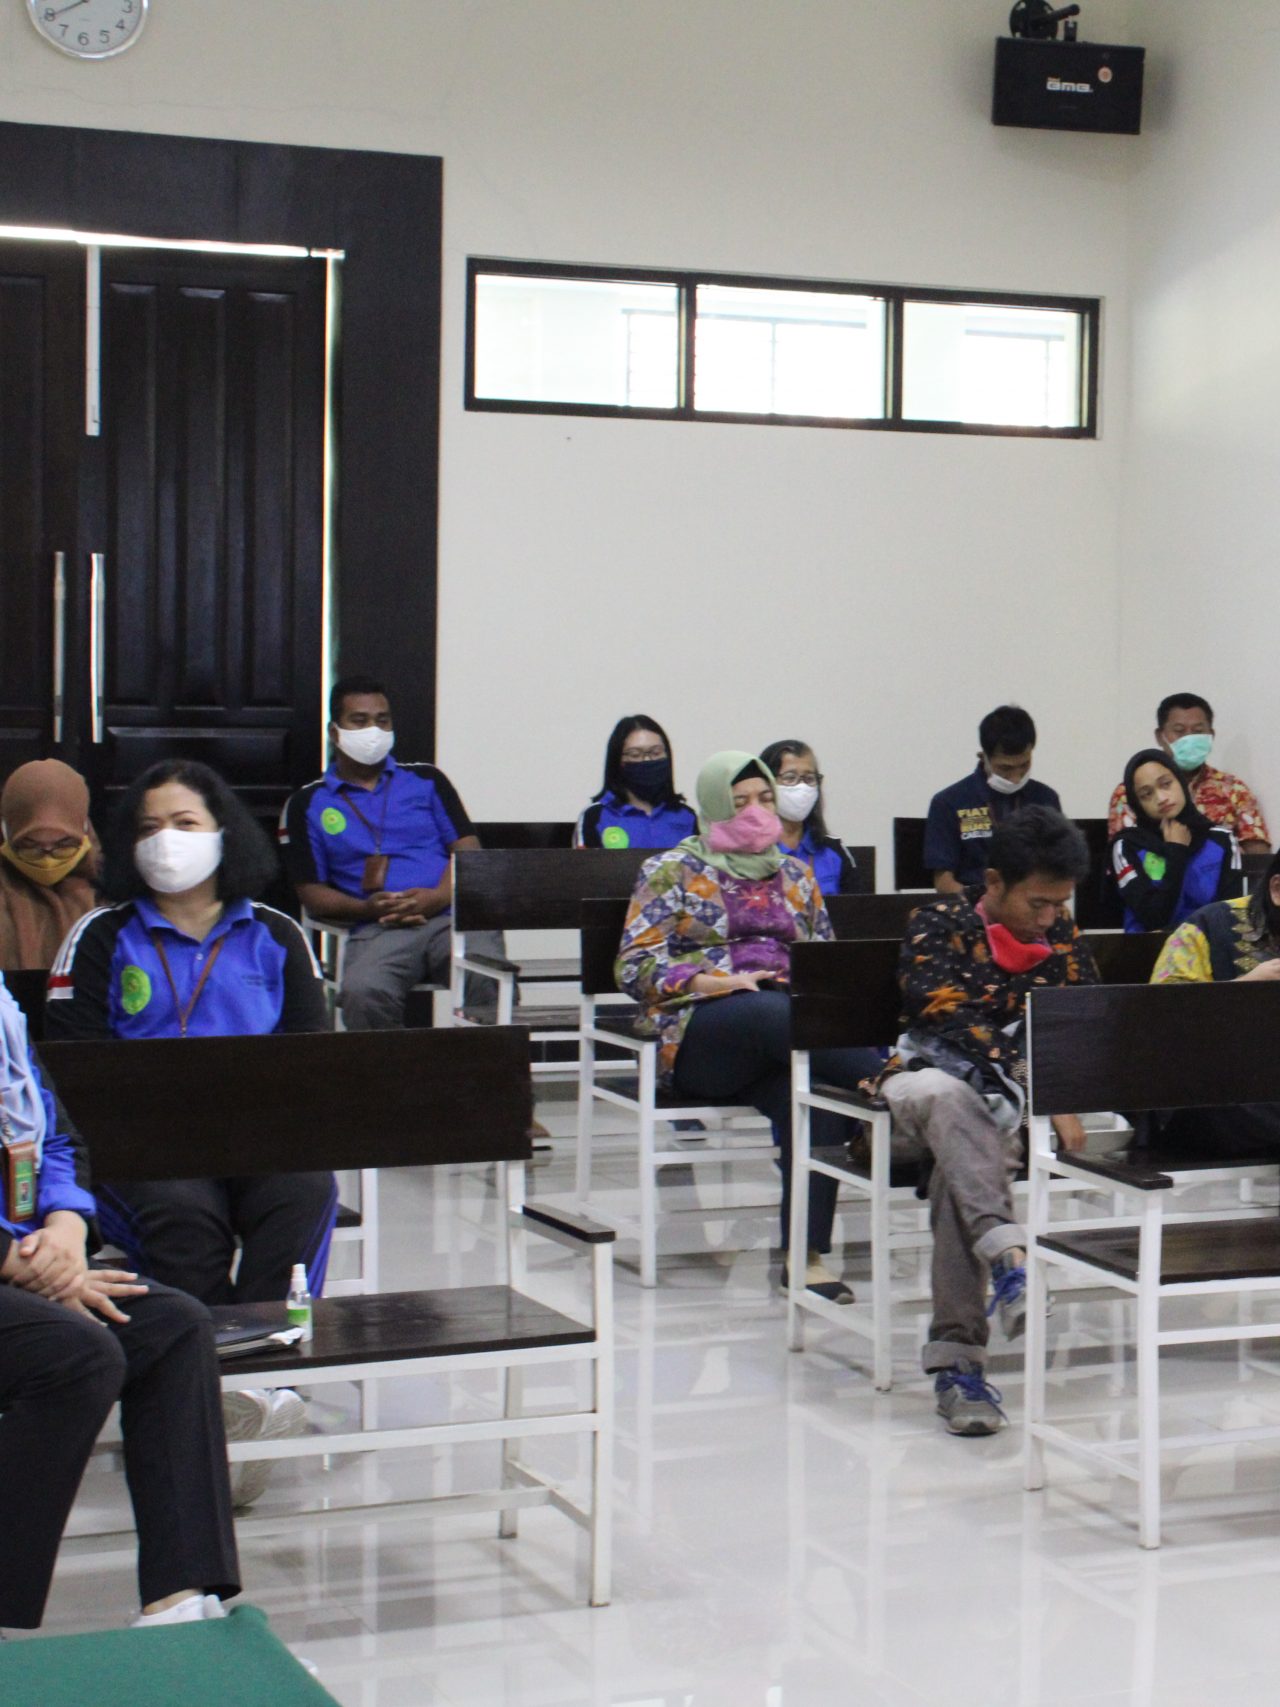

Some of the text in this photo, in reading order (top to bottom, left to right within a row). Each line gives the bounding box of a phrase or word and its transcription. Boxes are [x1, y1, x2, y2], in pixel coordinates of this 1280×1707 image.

[122, 0, 133, 13] 3
[45, 8, 56, 22] 8
[59, 24, 69, 37] 7
[115, 19, 125, 30] 4
[78, 32, 89, 46] 6
[99, 30, 110, 43] 5
